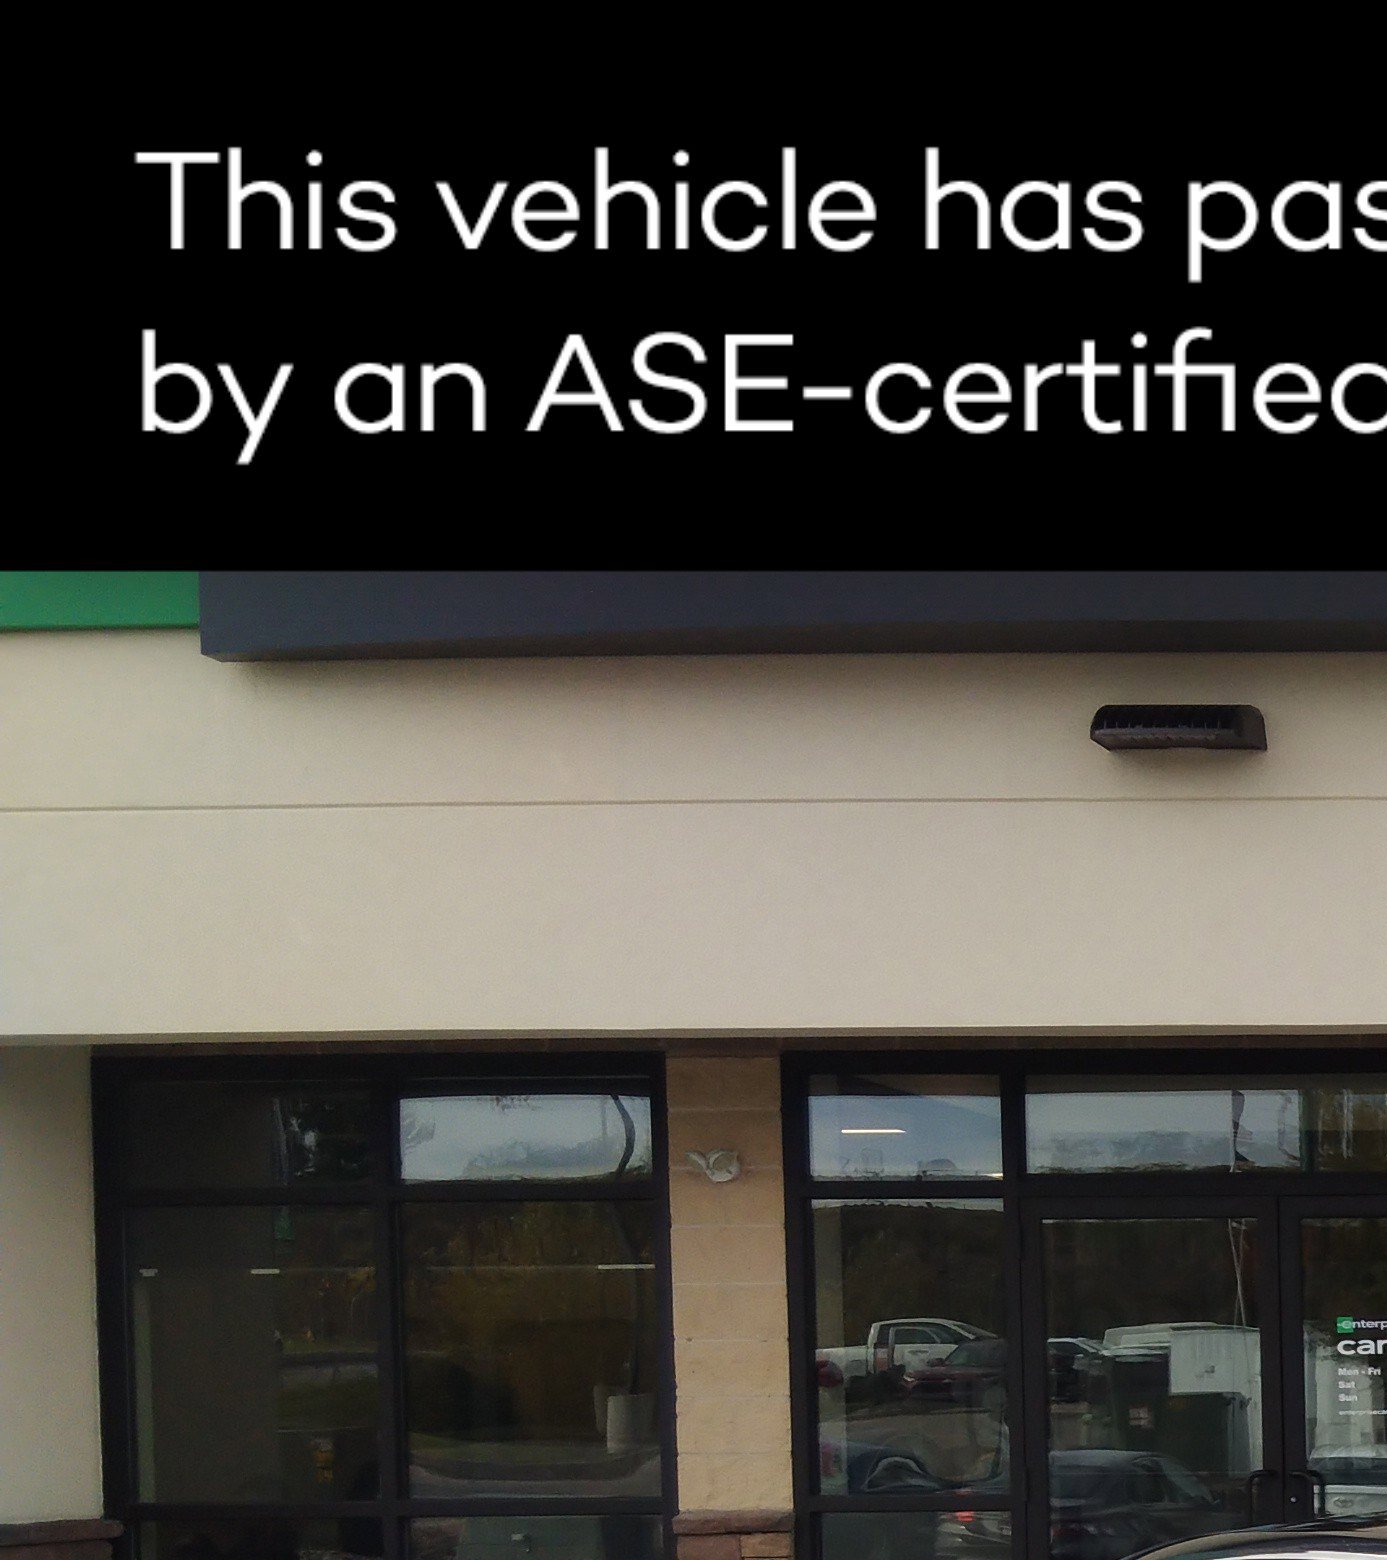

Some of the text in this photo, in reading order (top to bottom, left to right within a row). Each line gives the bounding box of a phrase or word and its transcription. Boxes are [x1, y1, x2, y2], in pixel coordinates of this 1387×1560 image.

[1367, 1366, 1382, 1376] Fri
[1338, 1380, 1356, 1389] Sat
[1338, 1393, 1358, 1402] Sun
